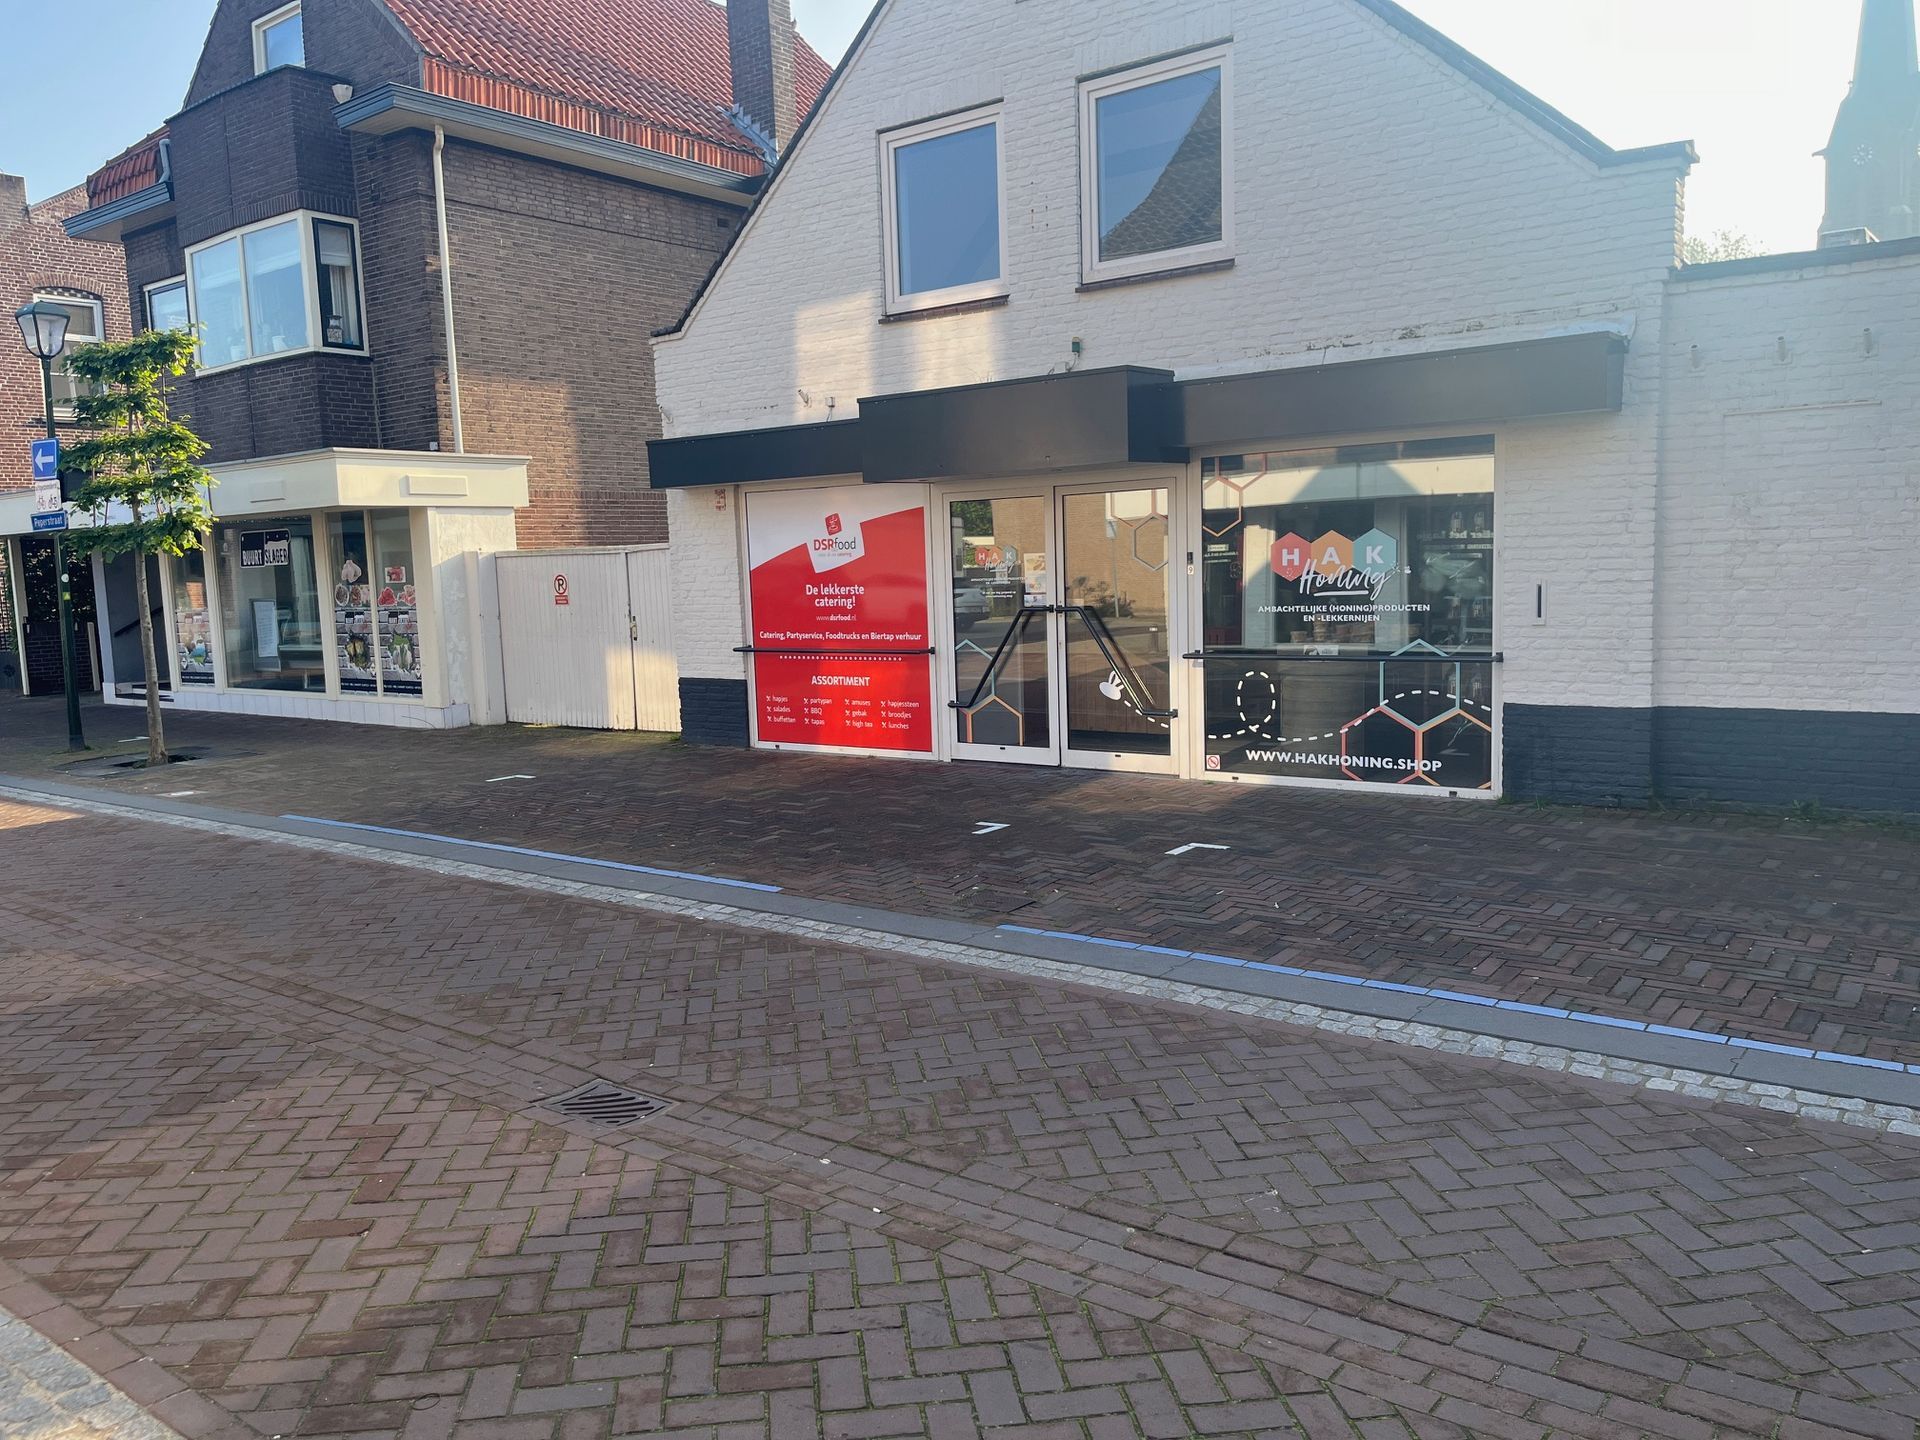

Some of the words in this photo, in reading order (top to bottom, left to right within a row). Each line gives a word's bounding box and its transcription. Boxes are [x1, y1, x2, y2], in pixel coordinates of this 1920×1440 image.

[813, 536, 856, 551] DSRfood
[242, 549, 263, 566] BUURT
[265, 548, 288, 565] SLAGER
[978, 552, 1012, 560] HAK
[1282, 546, 1383, 566] HAK
[1299, 558, 1392, 600] Honing
[805, 584, 818, 595] De
[820, 584, 865, 596] lekkerste
[815, 596, 856, 609] catering!
[1258, 604, 1328, 614] AMBACHTELIJKE
[1329, 604, 1431, 613] (HONING)PRODUCTEN
[1303, 614, 1316, 622] EN
[1317, 614, 1381, 623] -LEKKERNIJEN
[759, 631, 786, 640] Catering,
[787, 632, 825, 641] Partyservice,
[826, 632, 860, 640] Foodtrucks
[870, 632, 894, 642] Biertap
[895, 632, 922, 641] verhuur
[811, 675, 870, 686] ASSORTIMENT
[772, 695, 788, 703] hapjes
[810, 707, 822, 715] BBQ
[888, 711, 911, 719] broodjes
[811, 718, 825, 726] tapas
[852, 720, 863, 728] high
[888, 721, 909, 729] lunches
[1245, 749, 1443, 772] WWW.HAKHONING.SHOP
